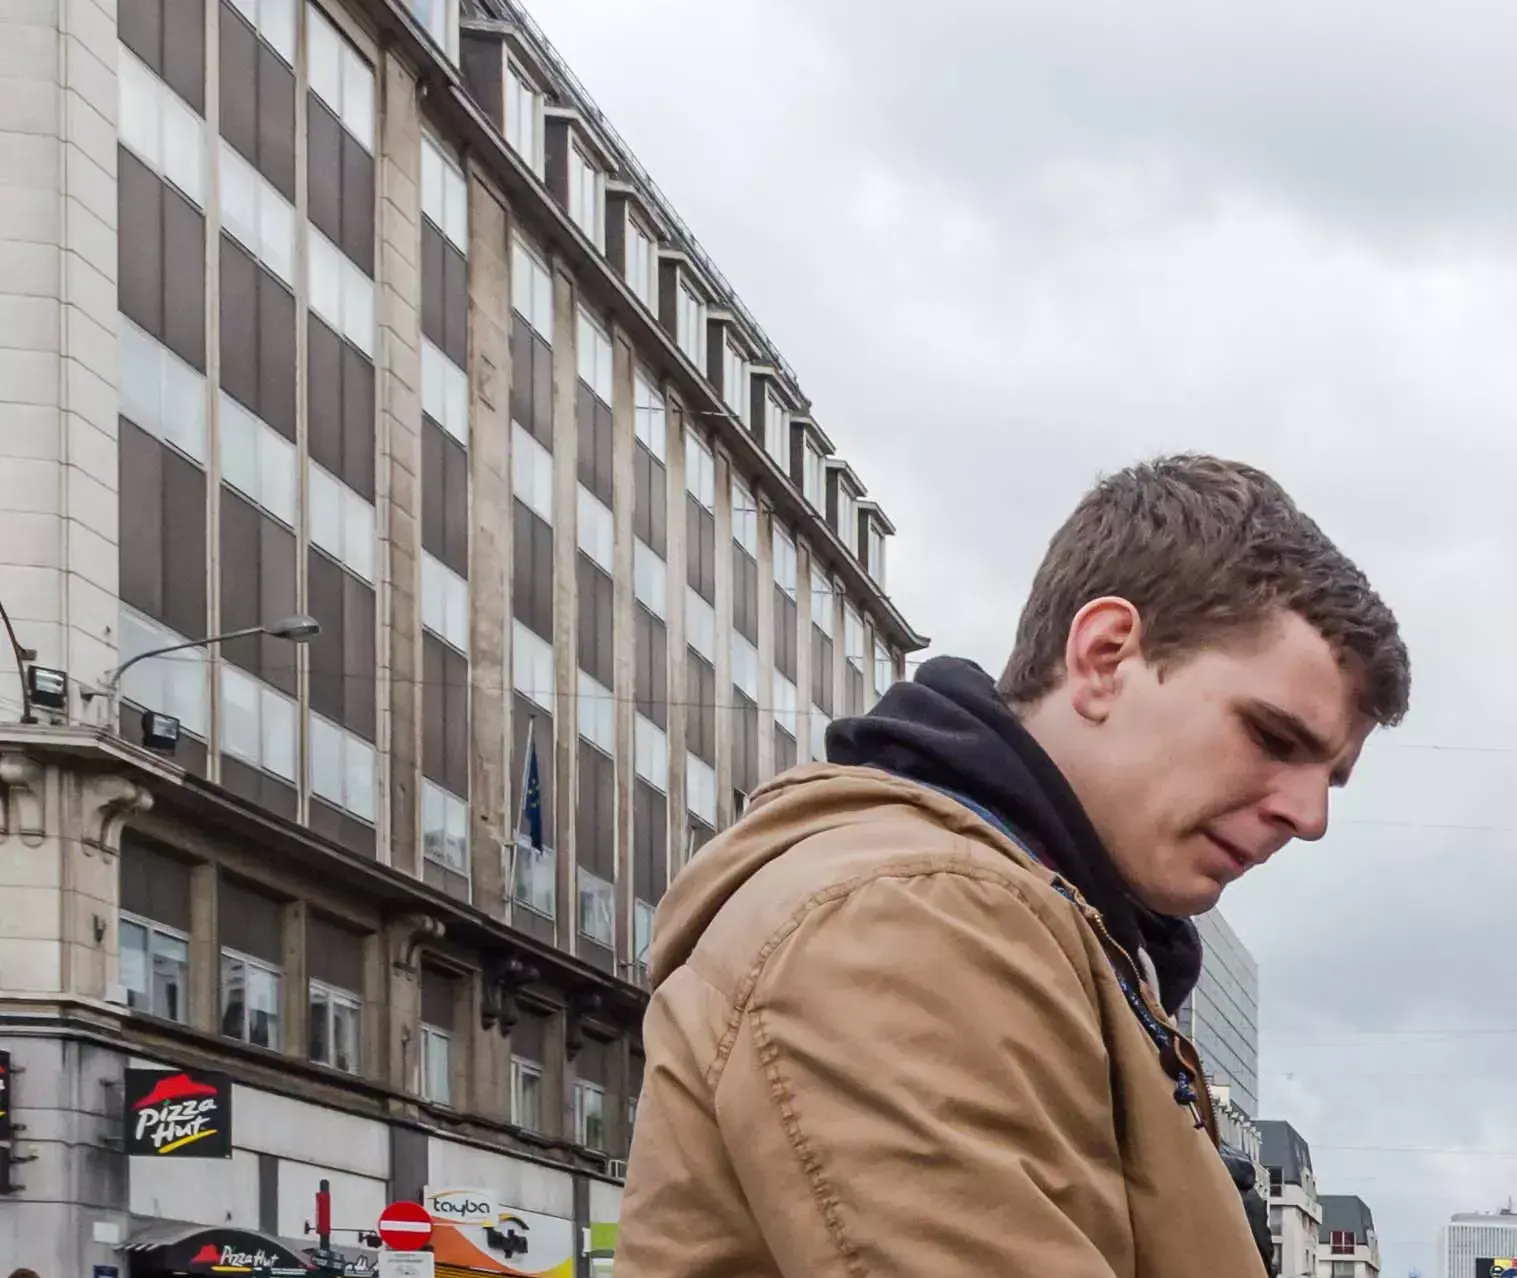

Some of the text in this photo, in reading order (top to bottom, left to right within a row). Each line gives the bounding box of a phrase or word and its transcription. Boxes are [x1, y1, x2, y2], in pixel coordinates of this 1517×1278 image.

[135, 1098, 217, 1140] Pizza
[151, 1115, 211, 1147] Hut
[433, 1198, 490, 1217] tayba
[220, 1245, 279, 1267] Pizza Hut
